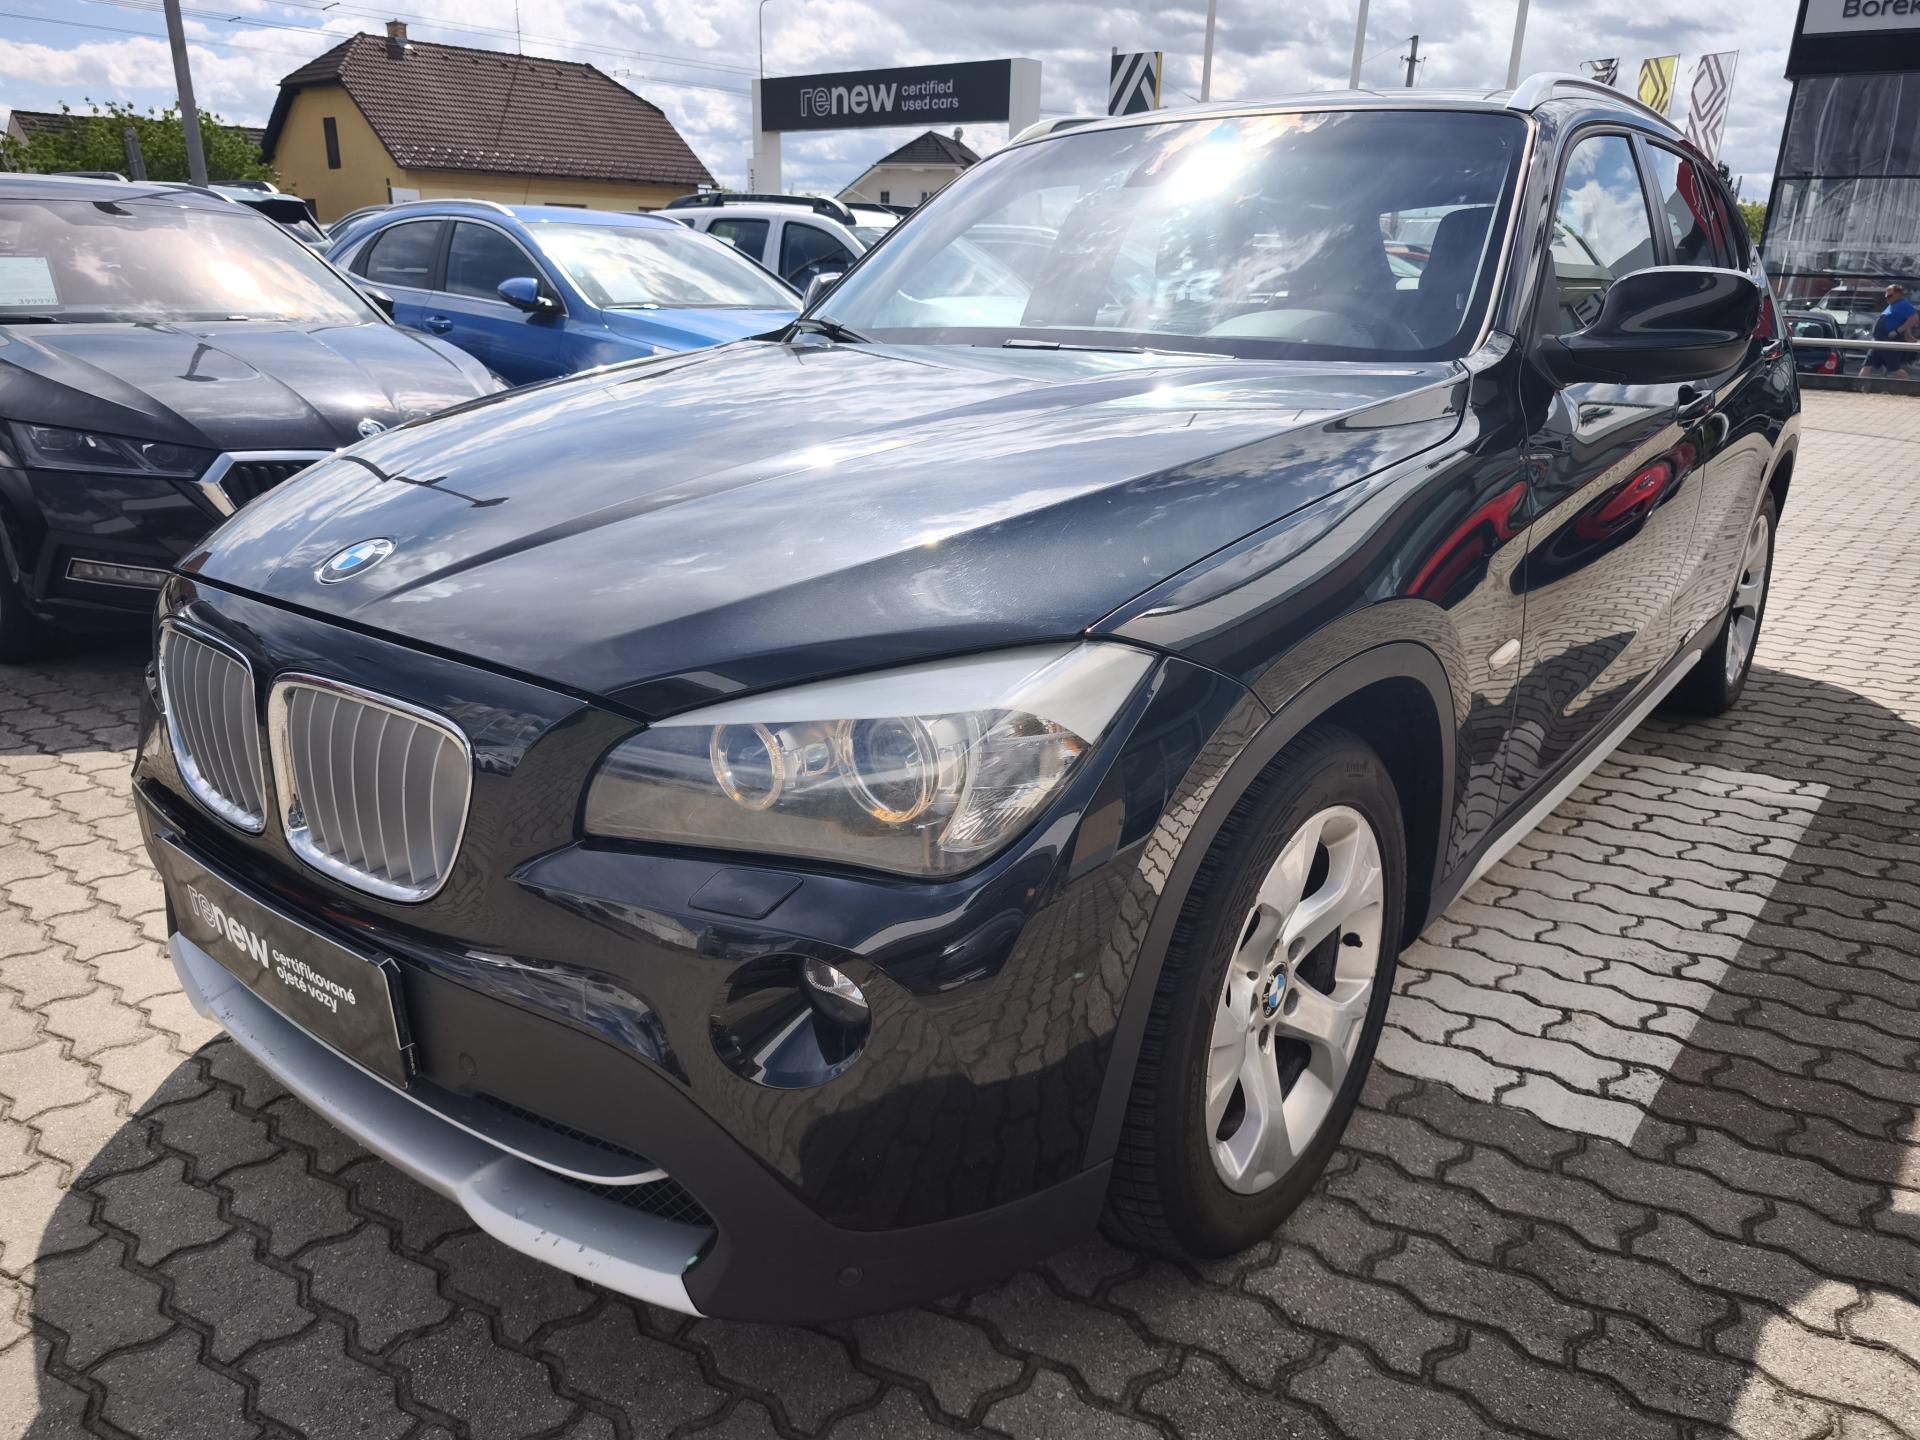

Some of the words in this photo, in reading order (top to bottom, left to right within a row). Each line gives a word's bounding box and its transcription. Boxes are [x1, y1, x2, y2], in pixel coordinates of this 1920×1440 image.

[800, 83, 897, 117] renew
[901, 98, 930, 110] used
[932, 97, 959, 109] cars
[902, 79, 953, 96] certified
[187, 884, 270, 968] renew
[272, 948, 356, 1005] certifikované
[277, 967, 307, 993] ojeté
[307, 983, 338, 1013] vozy
